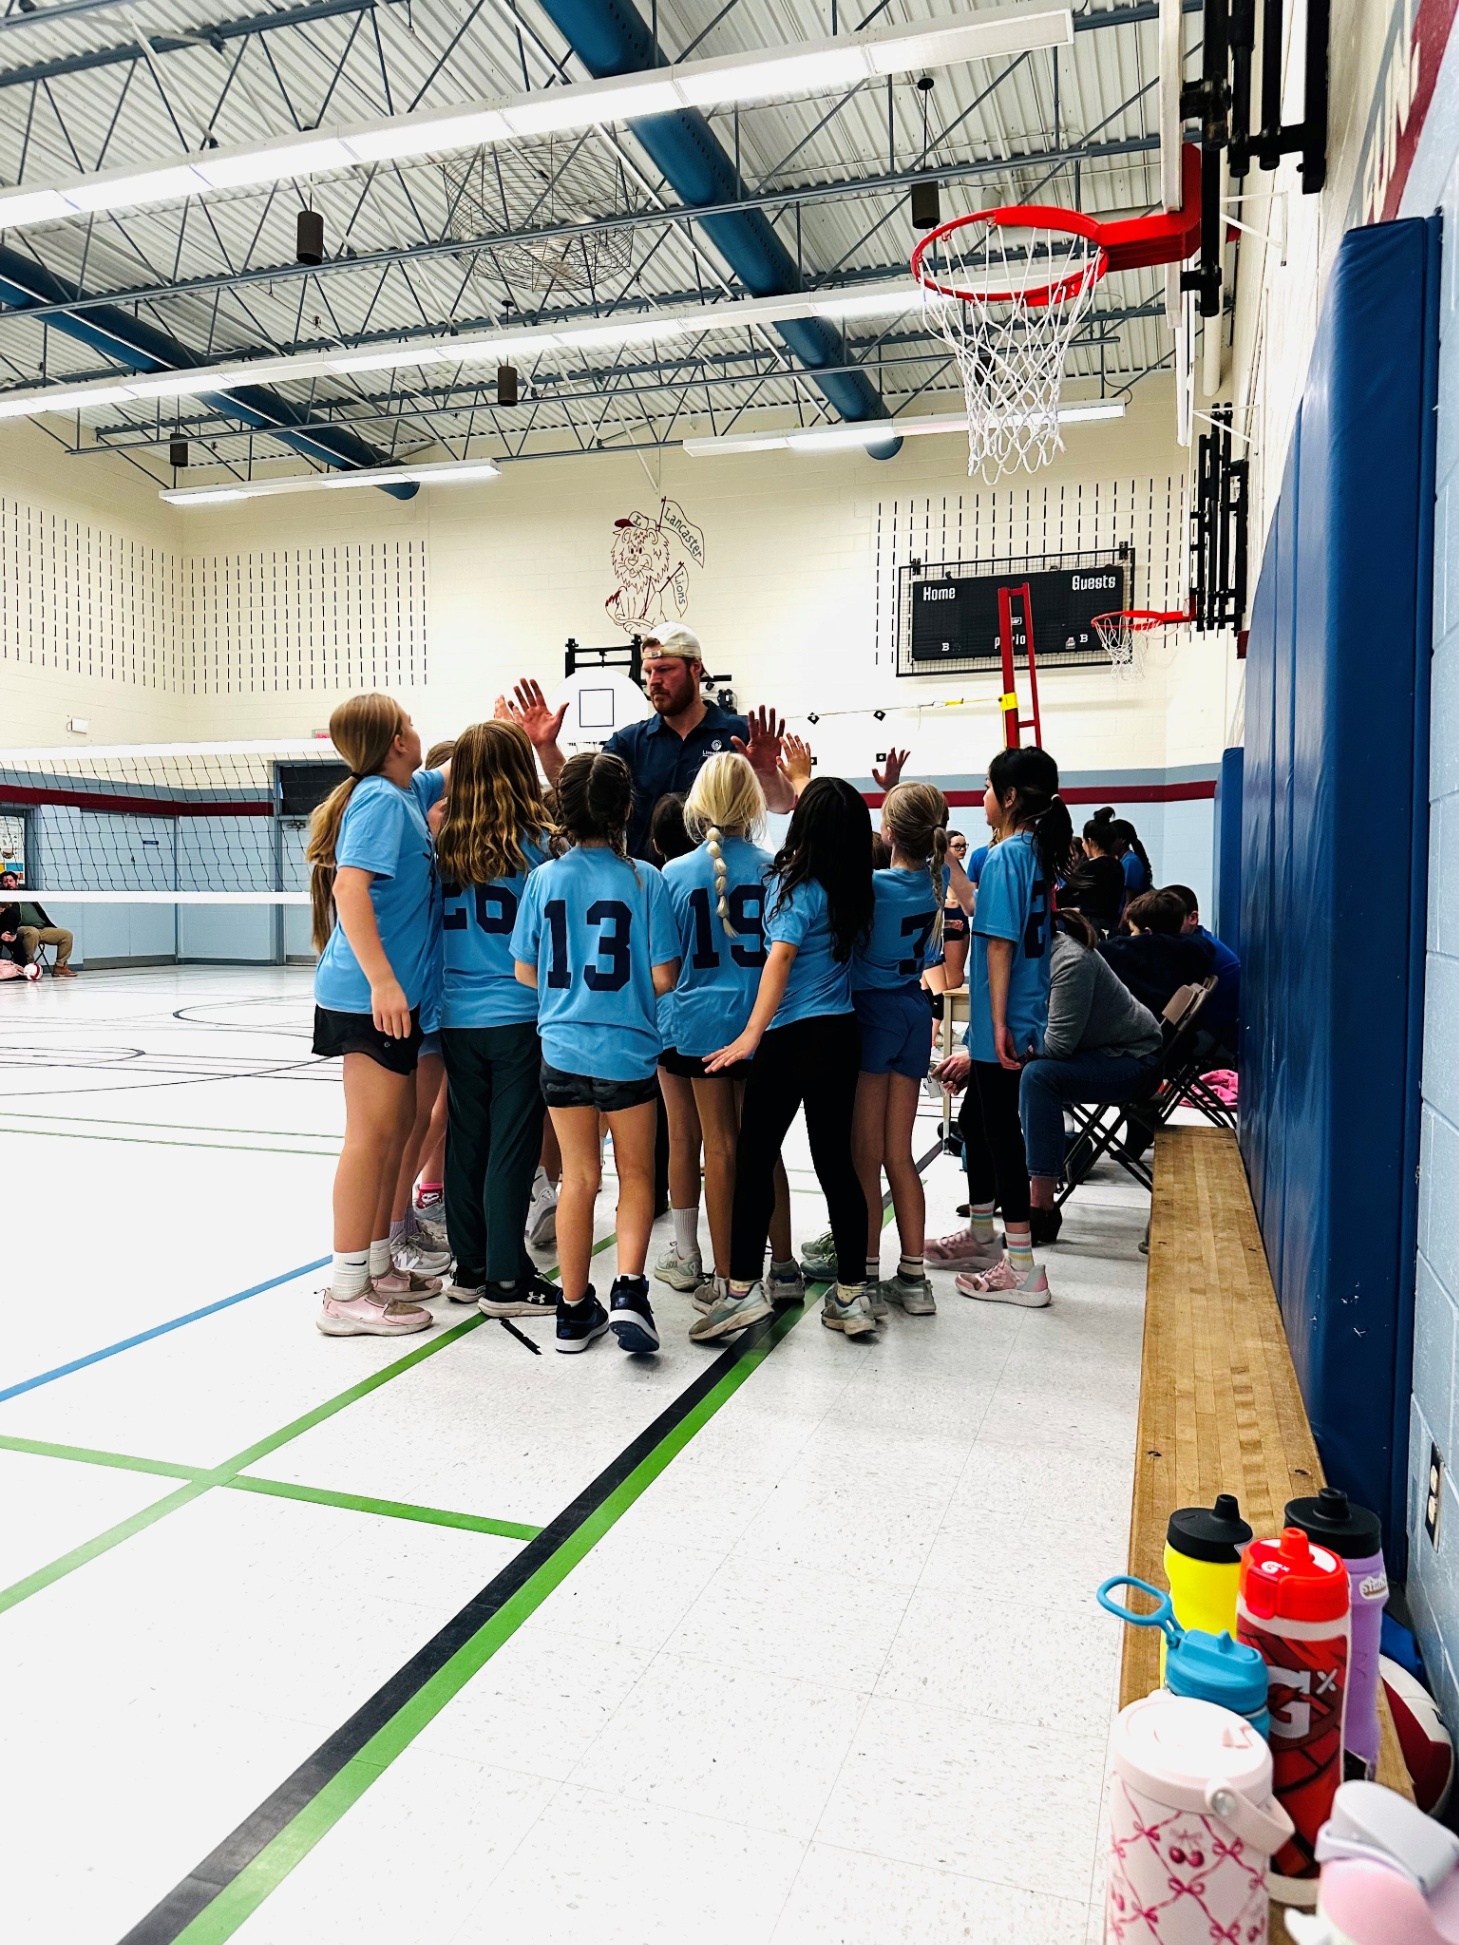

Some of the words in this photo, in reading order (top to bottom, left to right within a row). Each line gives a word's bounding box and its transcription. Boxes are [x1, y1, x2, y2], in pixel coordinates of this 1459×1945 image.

[663, 506, 702, 559] Lancaster
[674, 570, 687, 606] Lions
[922, 586, 956, 601] Home
[1071, 574, 1116, 591] Guests
[941, 642, 950, 651] B
[1079, 633, 1089, 643] B
[688, 884, 768, 970] 19
[543, 899, 633, 992] 13
